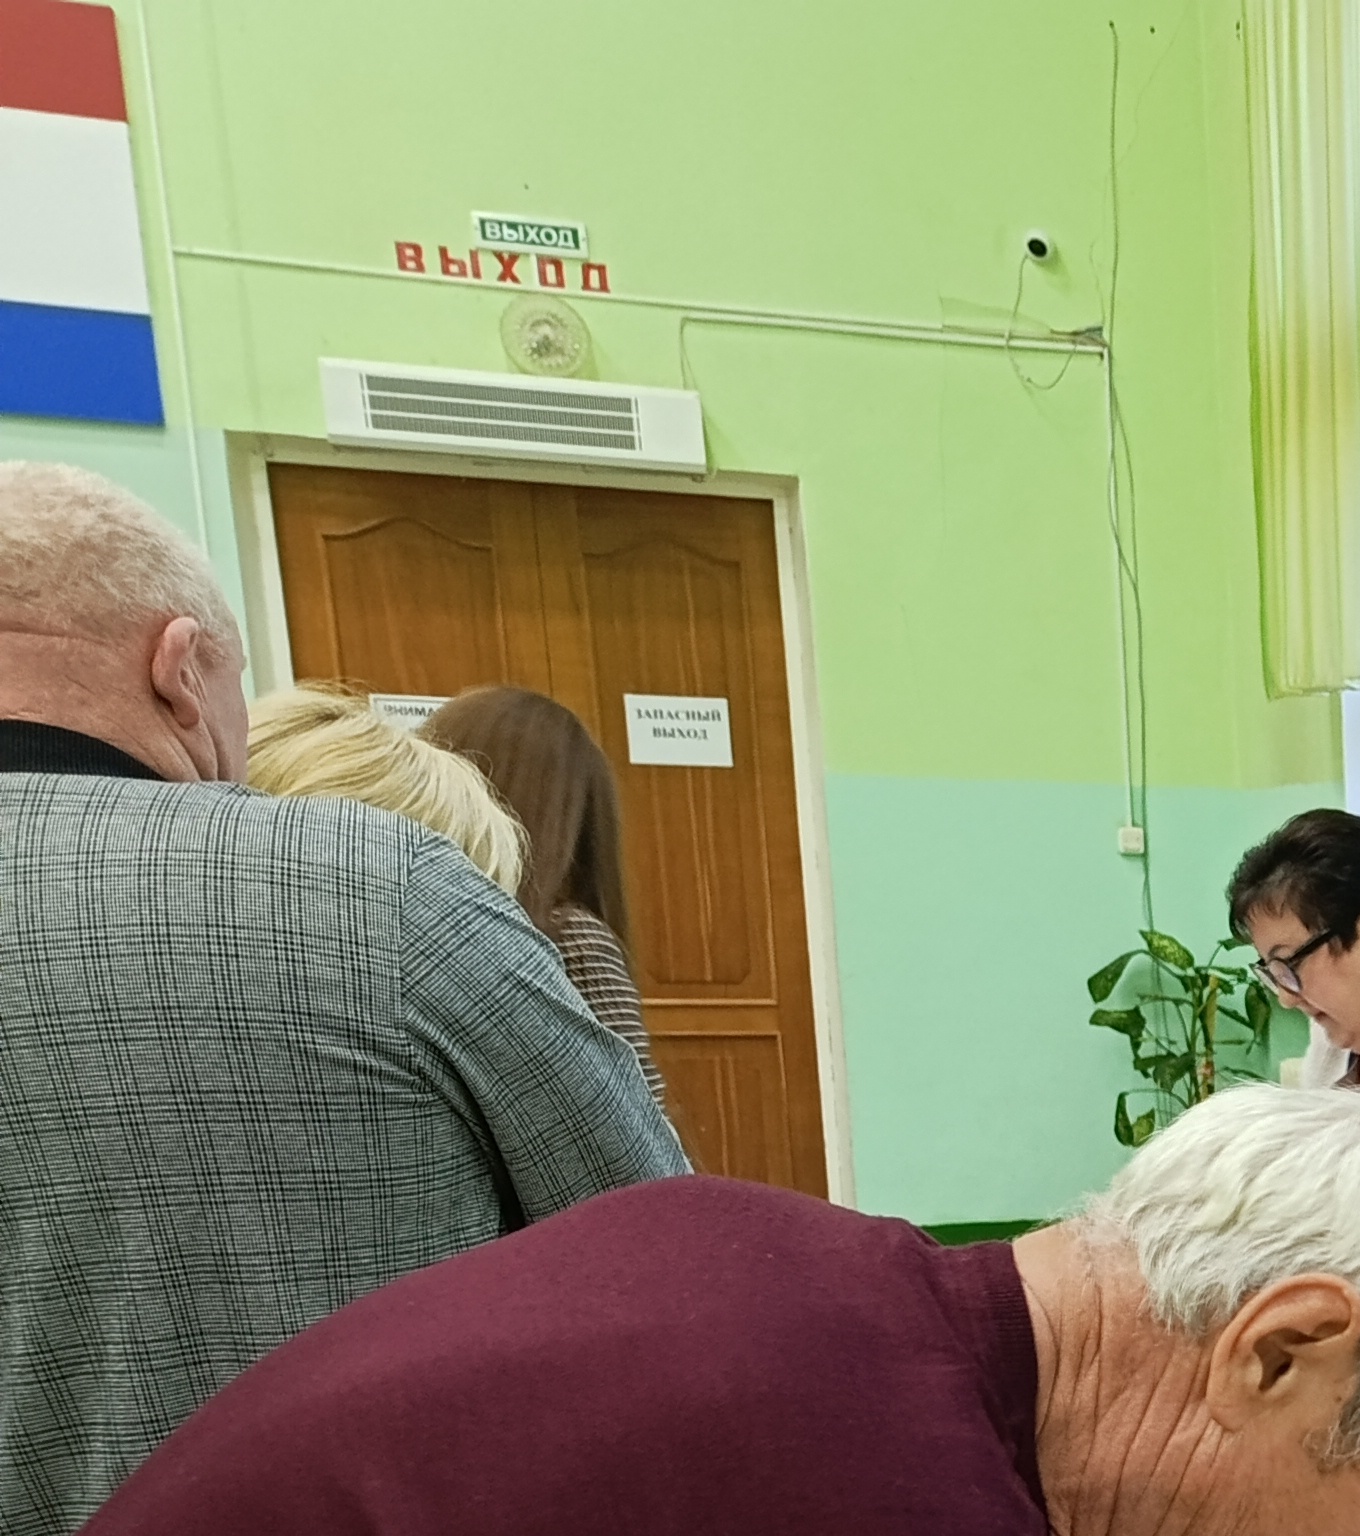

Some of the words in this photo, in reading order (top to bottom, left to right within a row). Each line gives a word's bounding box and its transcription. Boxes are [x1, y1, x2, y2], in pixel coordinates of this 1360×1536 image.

[484, 221, 576, 248] ВЫХОД
[395, 241, 610, 293] ВЫХОД
[636, 707, 722, 722] ЗАПАСНЫЙ
[652, 726, 708, 740] ВЫХОД
